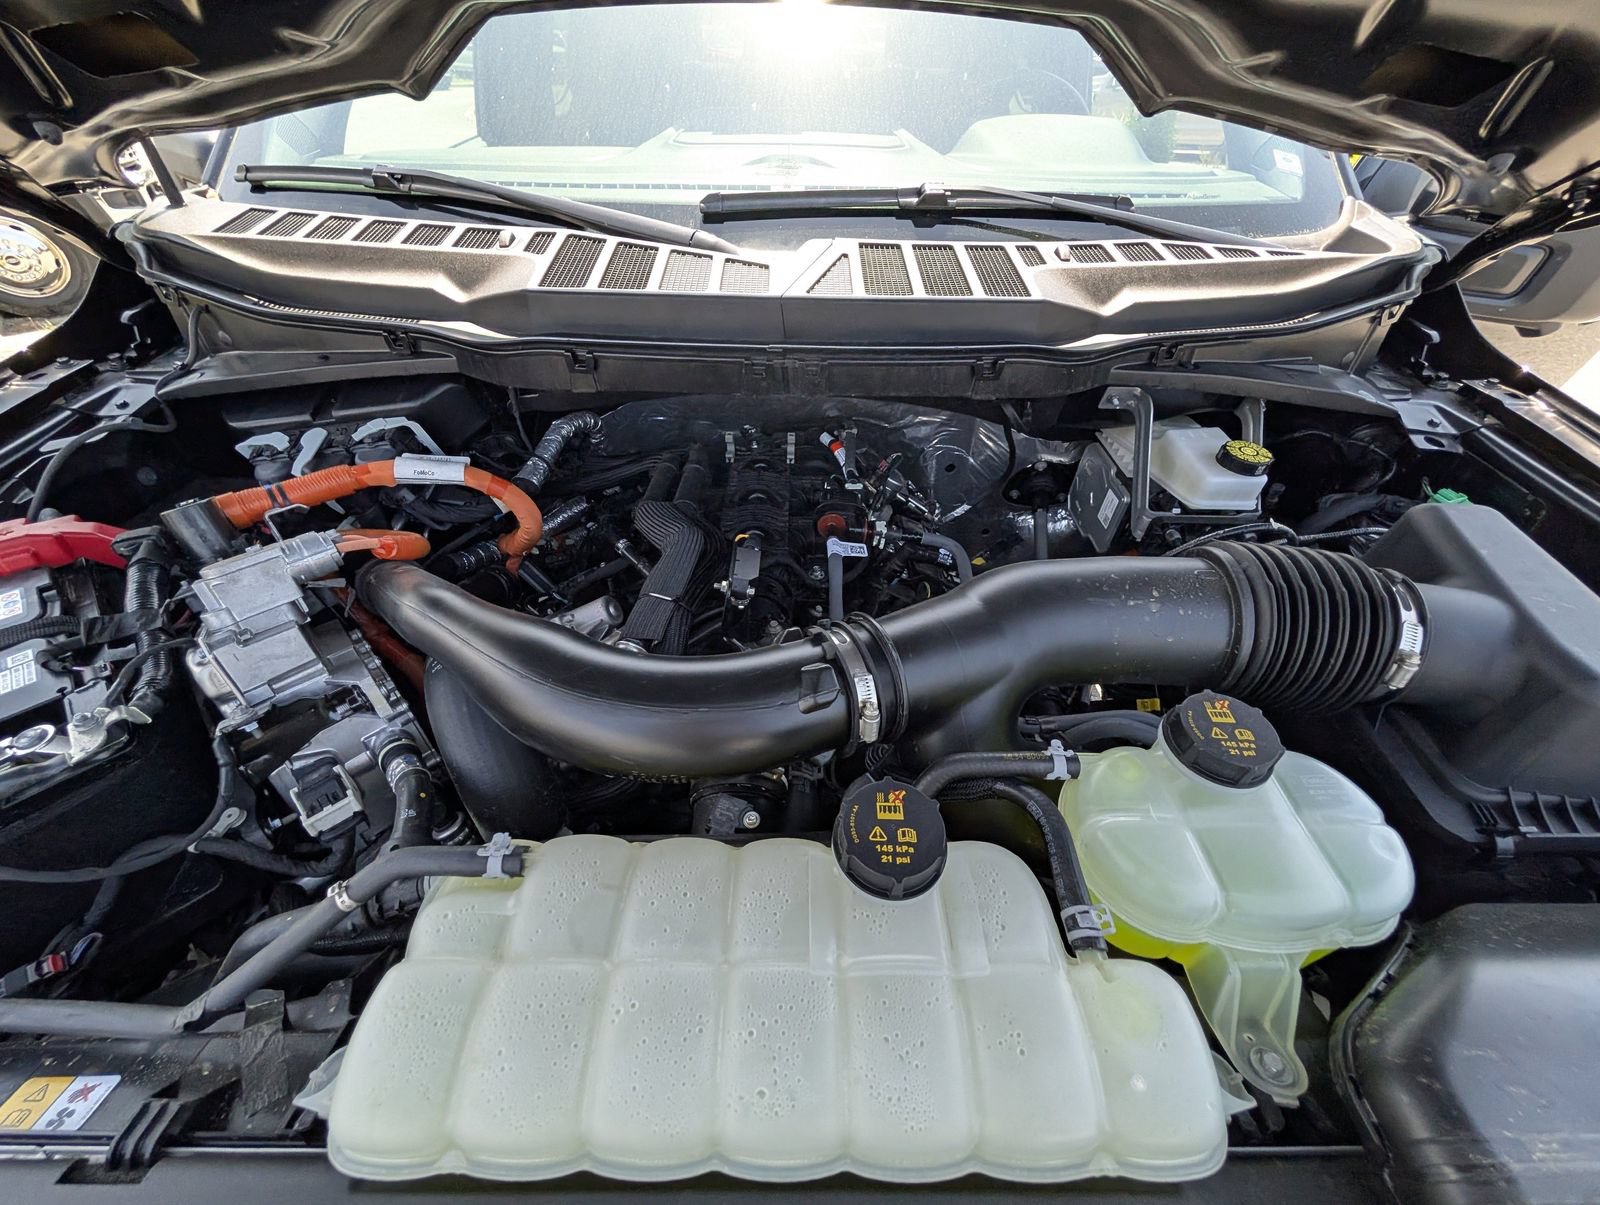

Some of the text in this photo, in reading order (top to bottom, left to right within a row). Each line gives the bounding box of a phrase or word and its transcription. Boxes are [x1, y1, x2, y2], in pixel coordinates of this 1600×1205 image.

[1238, 741, 1256, 749] kPa
[876, 845, 915, 853] 145 kPa
[881, 855, 911, 865] 21 psi
